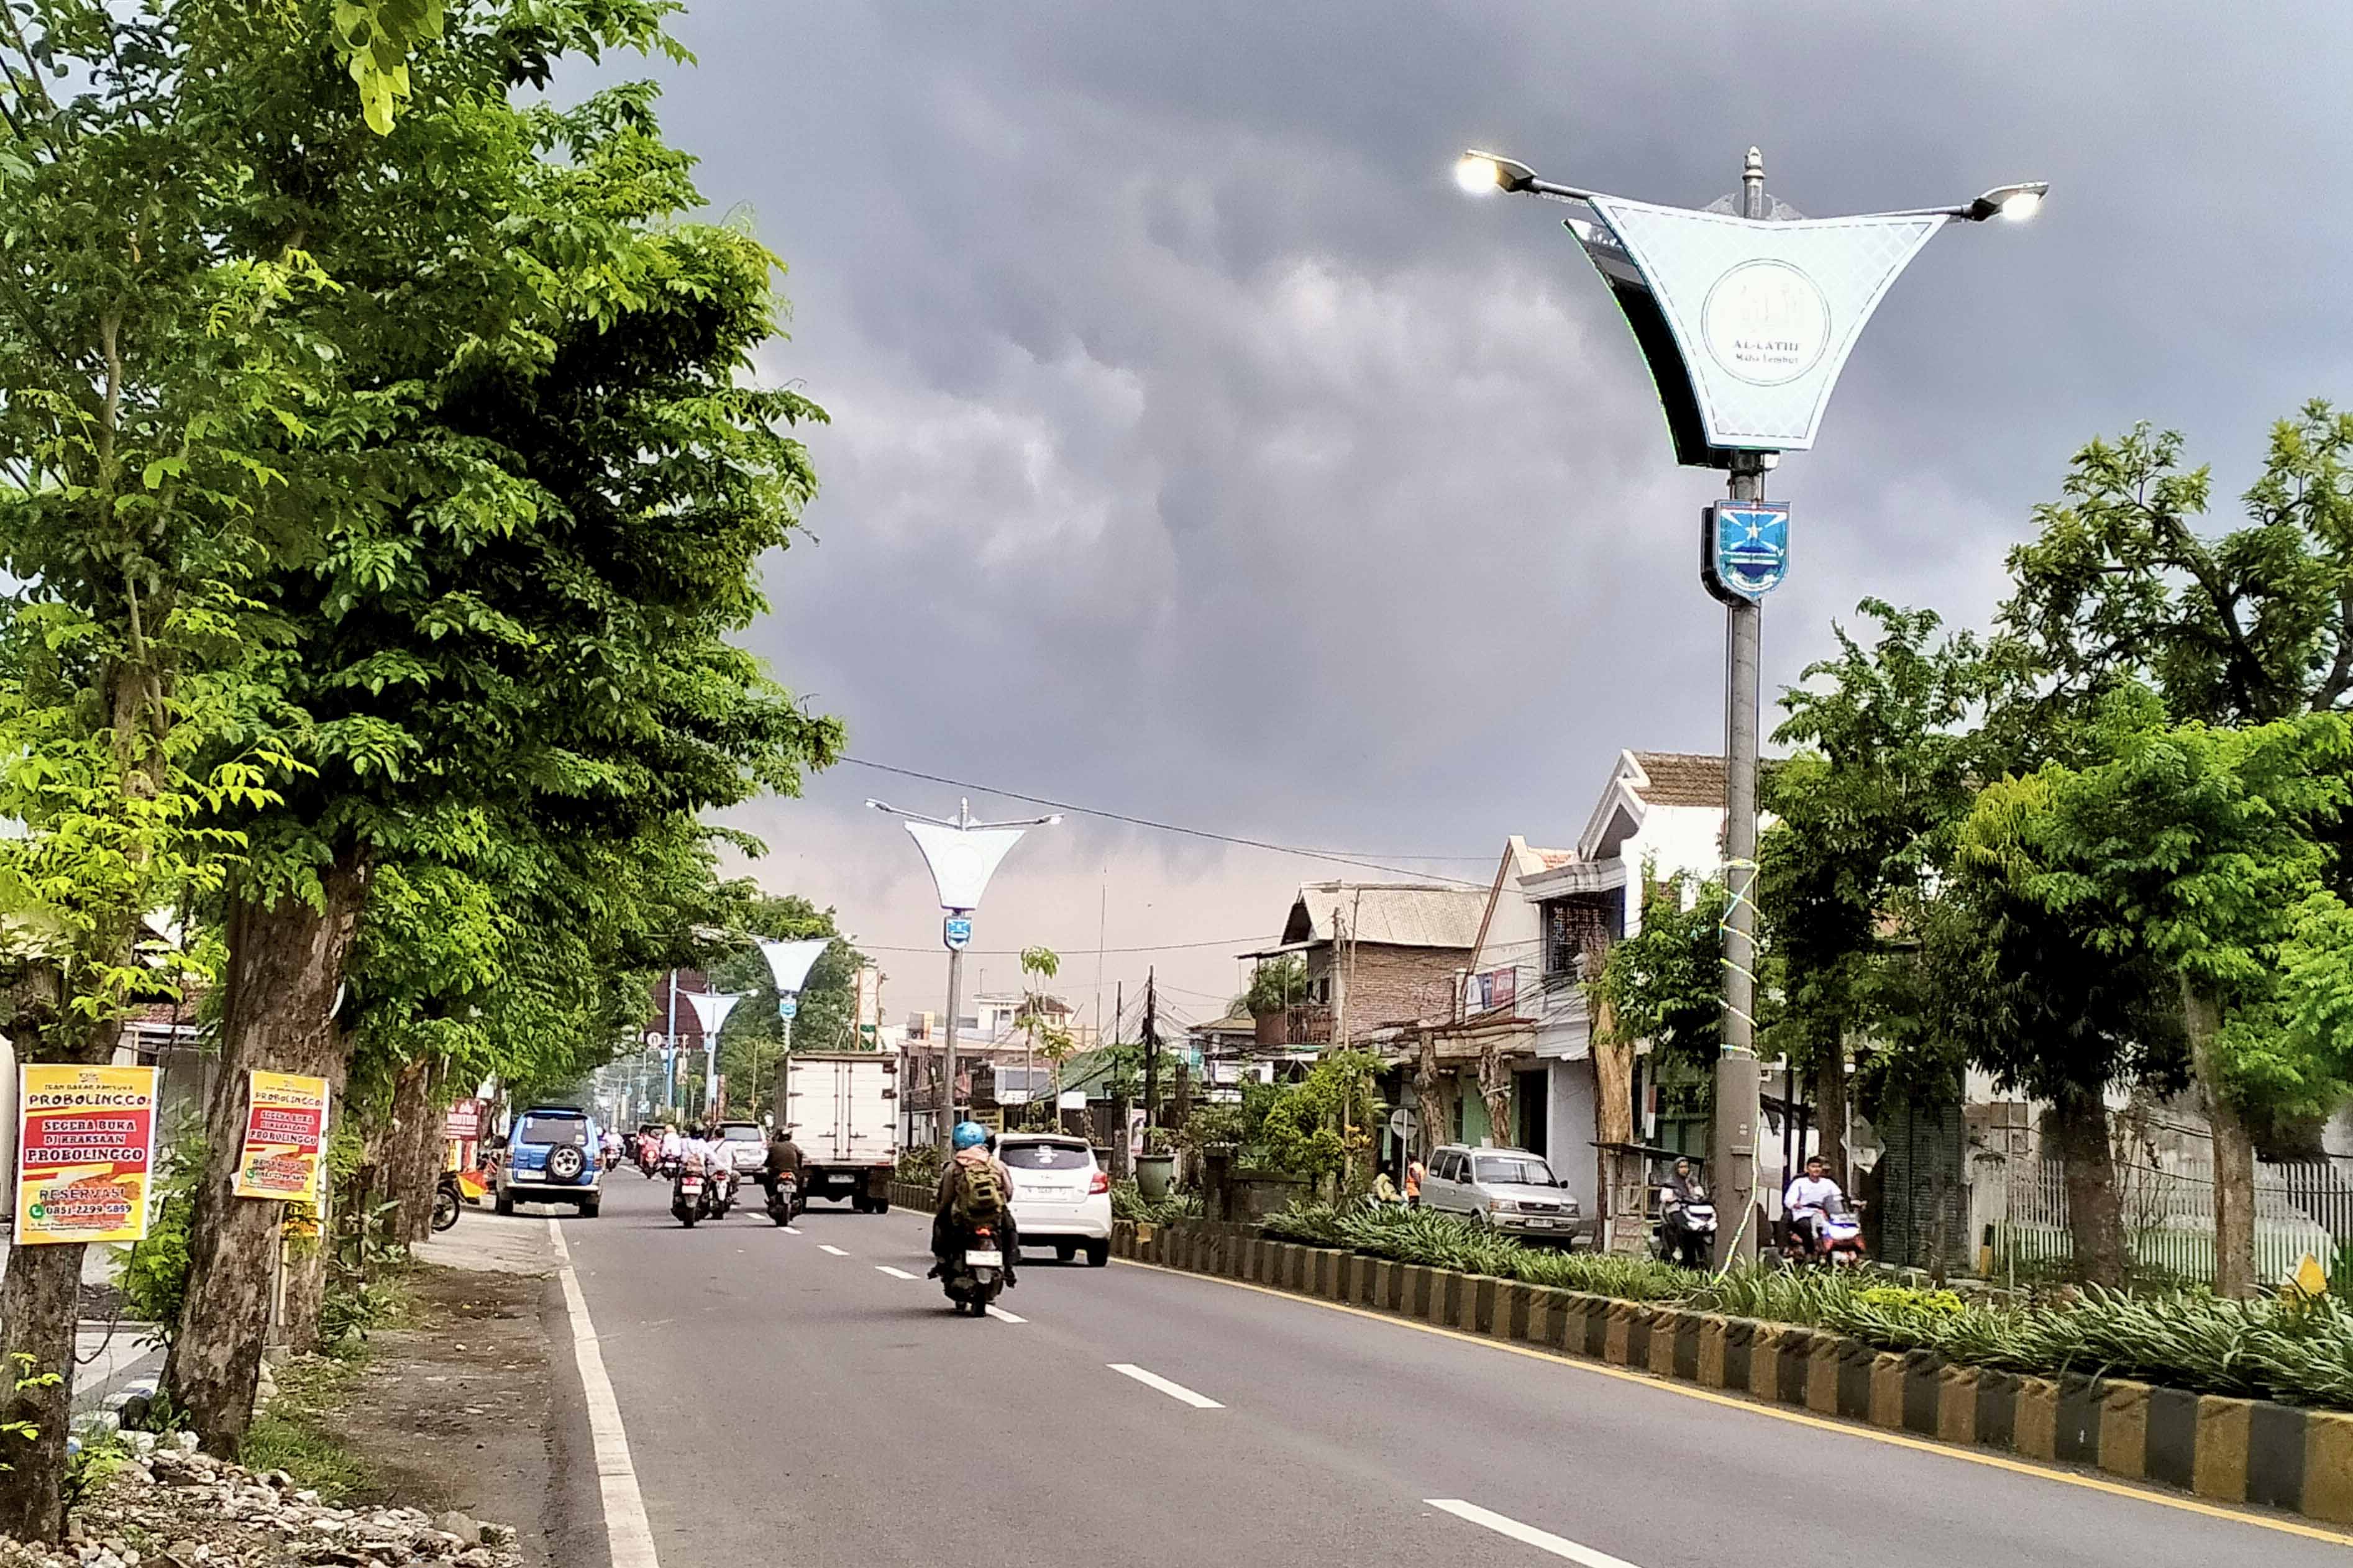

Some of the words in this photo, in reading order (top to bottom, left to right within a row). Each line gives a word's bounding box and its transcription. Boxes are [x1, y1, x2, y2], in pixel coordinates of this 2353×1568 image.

[43, 1121, 94, 1131] SEGERA
[99, 1121, 135, 1131] BUKA
[45, 1135, 59, 1144] DI
[62, 1135, 124, 1144] KRAKSAAN
[27, 1149, 143, 1161] PROBOLINGGO
[39, 1188, 124, 1200] RESERVASI
